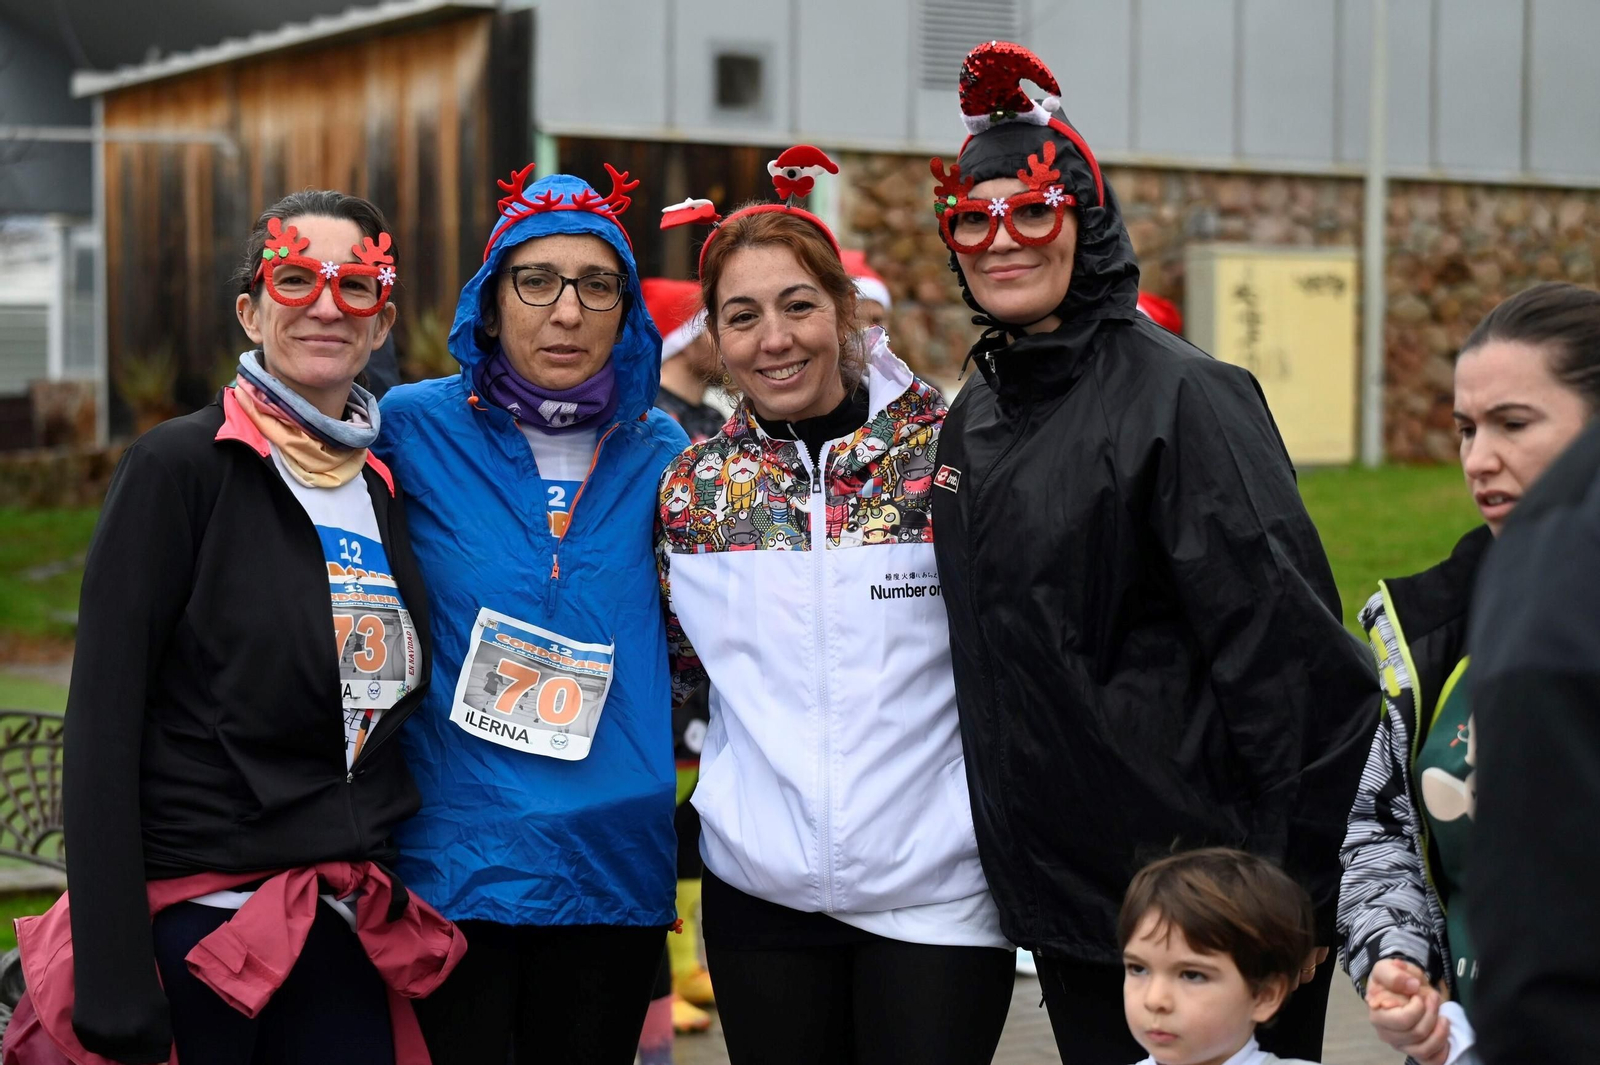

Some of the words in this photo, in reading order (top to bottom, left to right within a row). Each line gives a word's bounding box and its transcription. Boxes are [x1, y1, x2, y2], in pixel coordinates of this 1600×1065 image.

[545, 486, 566, 508] 2
[339, 538, 362, 564] 12
[344, 585, 364, 593] 12
[870, 583, 927, 600] Number
[332, 614, 388, 673] 73
[406, 630, 415, 665] NAVIDAD
[549, 643, 573, 657] 12
[493, 657, 583, 726] 70
